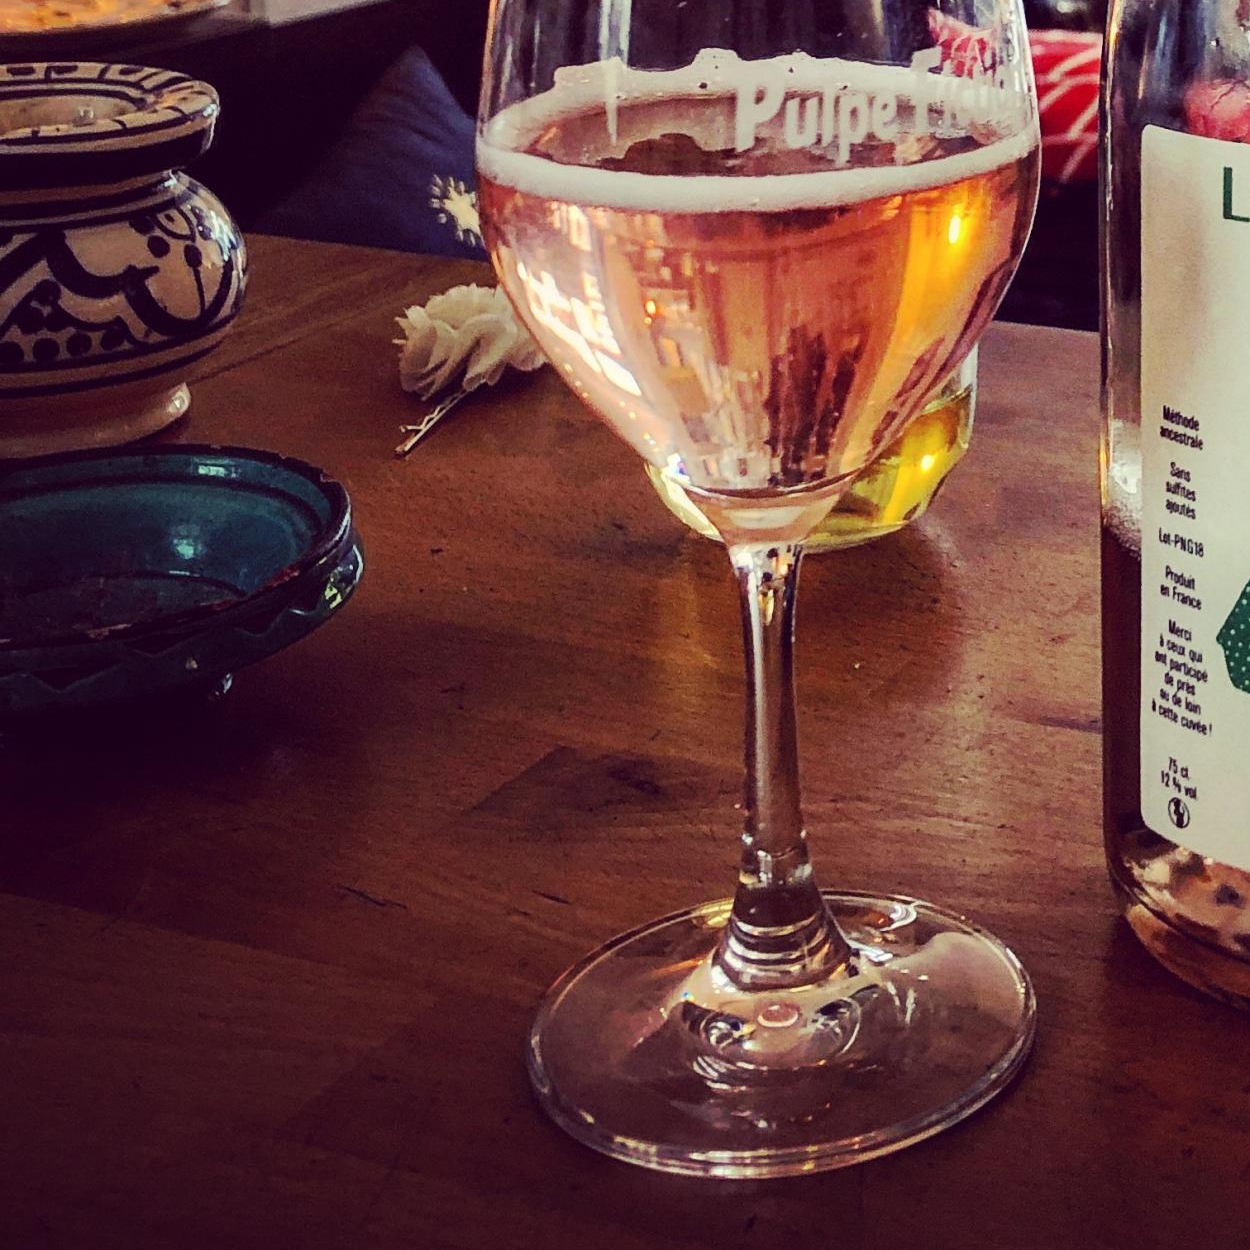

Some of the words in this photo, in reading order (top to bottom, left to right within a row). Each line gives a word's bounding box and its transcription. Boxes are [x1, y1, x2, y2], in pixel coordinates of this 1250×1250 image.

[1172, 586, 1202, 610] France
[1168, 619, 1192, 642] Merci
[1168, 756, 1178, 774] 75
[1161, 770, 1170, 788] 12
